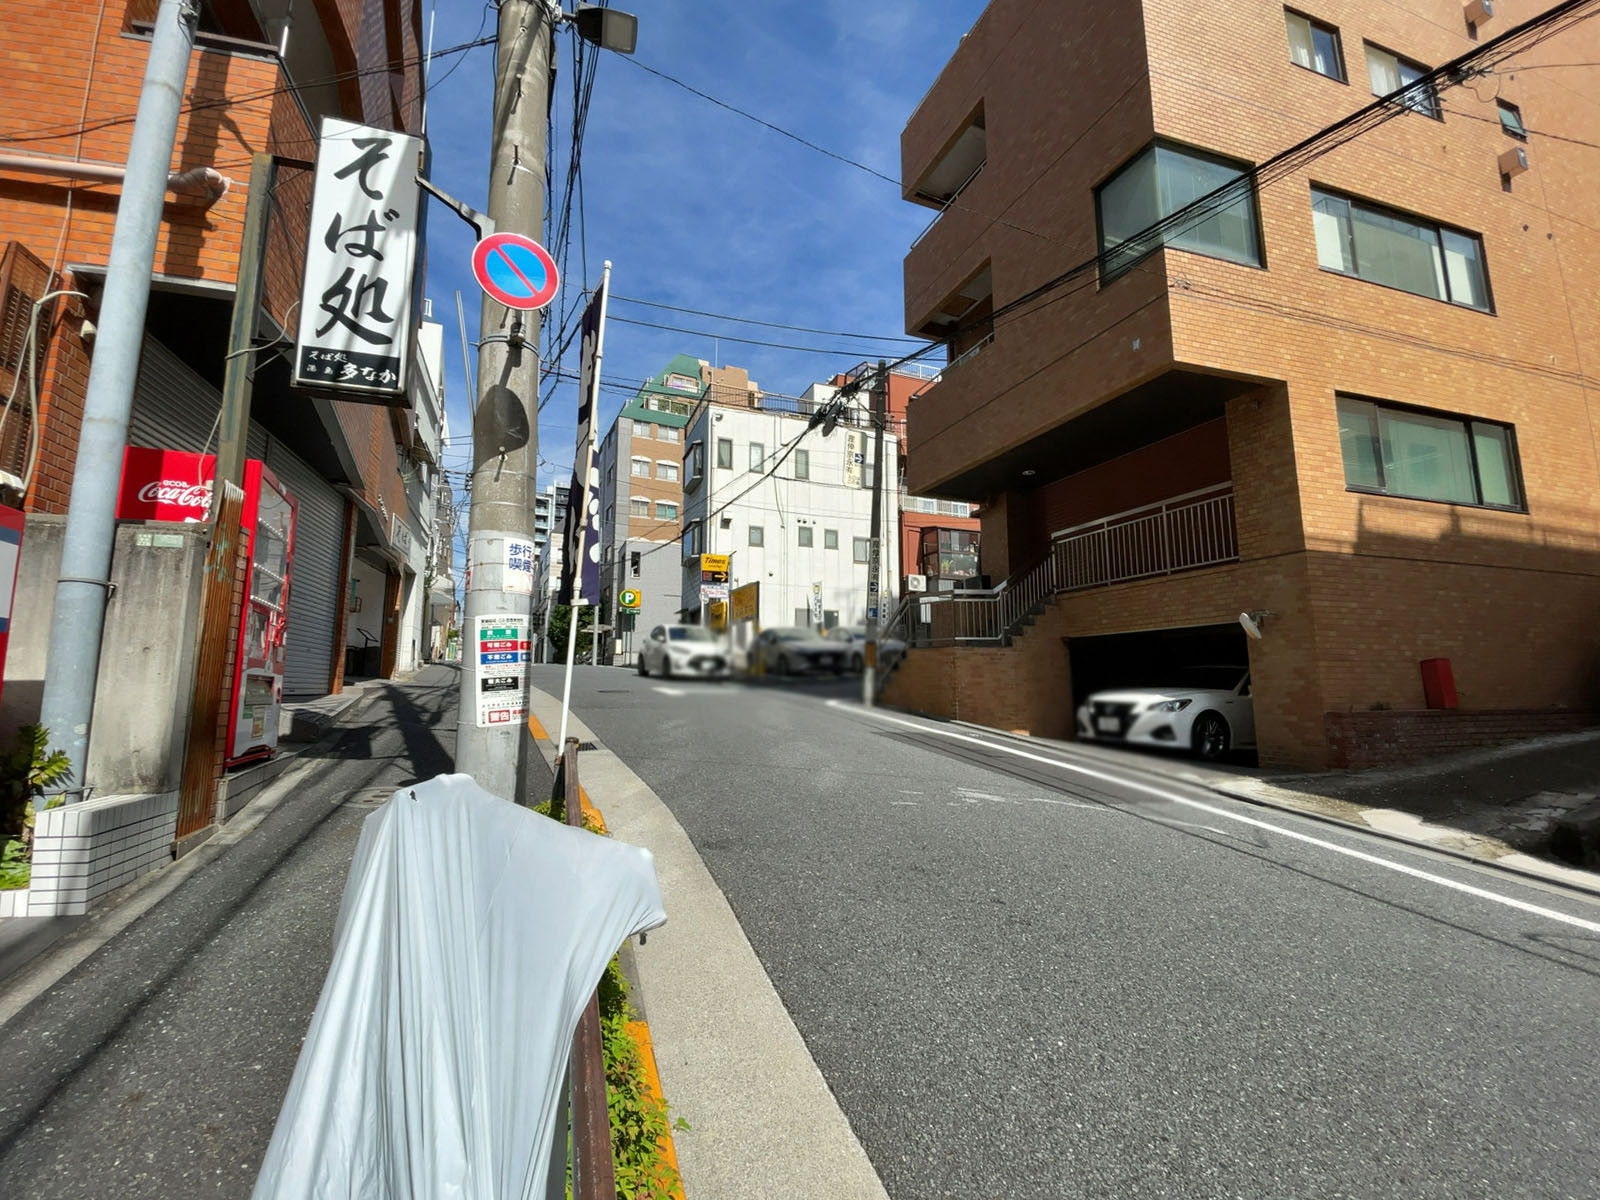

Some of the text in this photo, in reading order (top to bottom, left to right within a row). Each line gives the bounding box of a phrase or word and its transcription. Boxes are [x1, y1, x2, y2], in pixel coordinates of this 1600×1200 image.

[316, 137, 400, 346] そば処
[308, 350, 348, 363] そば処
[705, 556, 726, 565] Times
